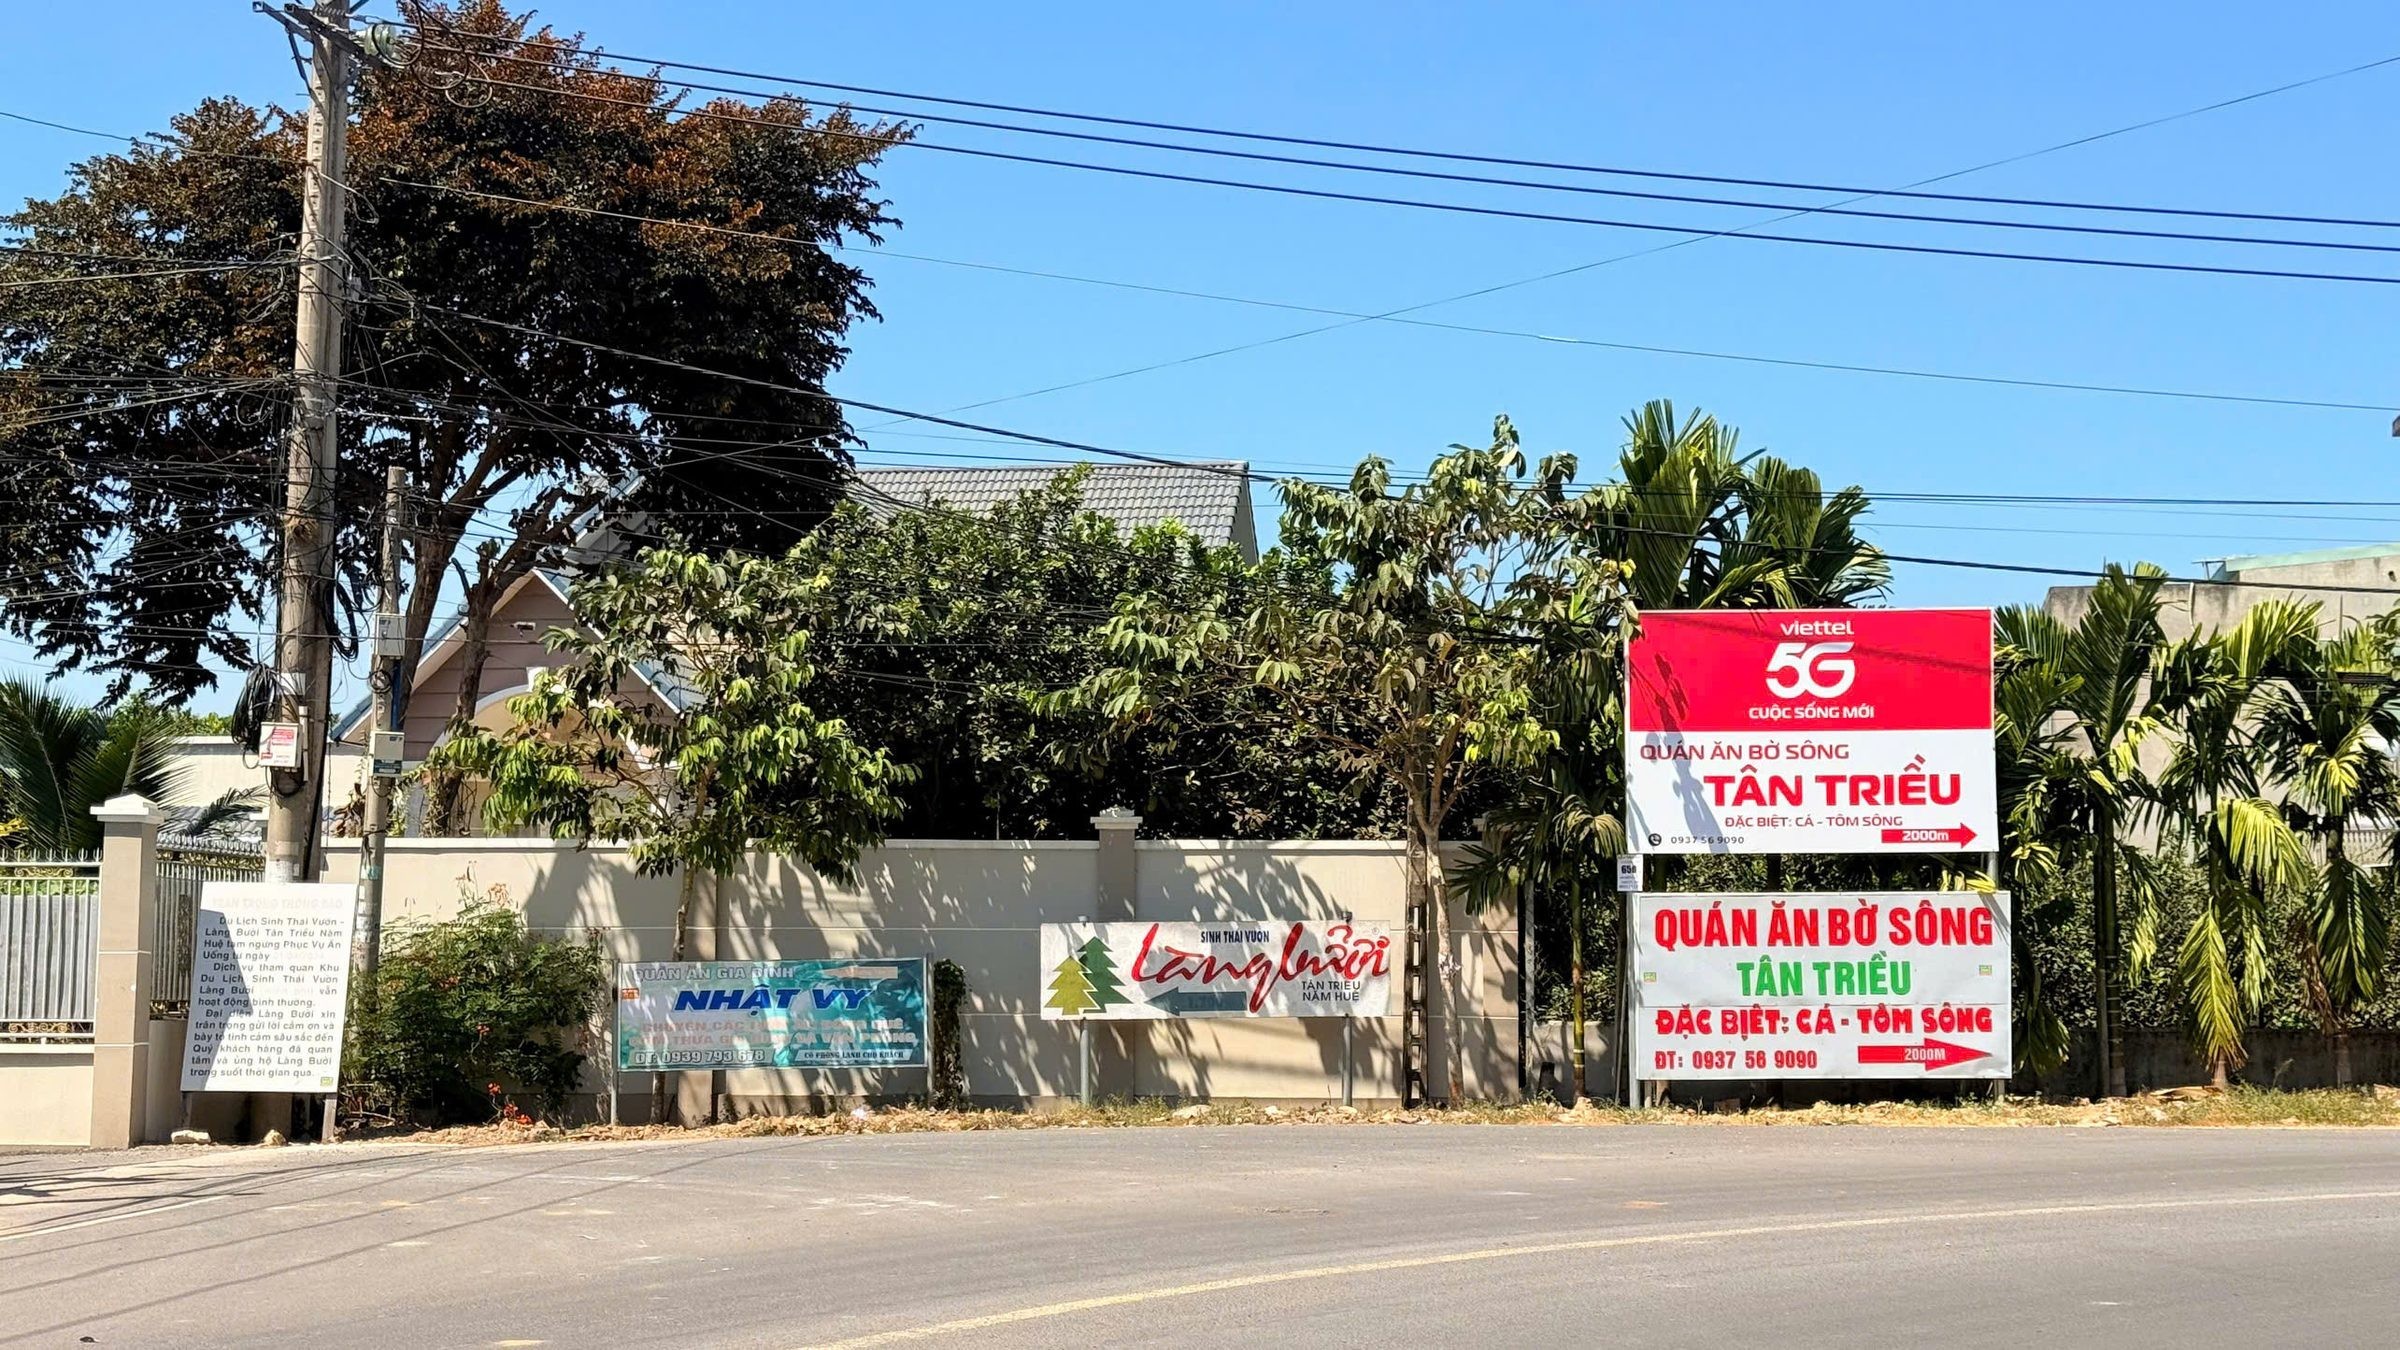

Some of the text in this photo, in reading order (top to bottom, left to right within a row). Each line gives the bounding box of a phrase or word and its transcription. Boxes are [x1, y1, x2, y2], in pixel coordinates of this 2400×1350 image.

[1780, 620, 1854, 636] viettel
[1766, 642, 1855, 698] 5G
[1749, 701, 1874, 721] CUỘC SỐNG MỚI
[1640, 740, 1849, 761] QUÁN ĂN BỜ SÔNG
[1704, 754, 1961, 807] TÂN TRIỀU
[1725, 813, 1753, 829] ĐẶC
[1757, 813, 1792, 829] BIỆT:
[1796, 813, 1814, 827] CÁ
[1827, 814, 1859, 827] TÔM
[1862, 813, 1902, 827] SÔNG
[1671, 836, 1744, 844] 0937 56 9090
[1902, 830, 1949, 842] 2000m
[219, 917, 233, 926] Du
[261, 917, 283, 926] Sinh
[1655, 899, 1993, 952] QUÁN ĂN BỜ SÔNG
[205, 929, 230, 938] Làng
[1201, 931, 1221, 944] SINH
[204, 940, 223, 949] Huệ
[203, 950, 229, 961] Uống
[214, 963, 235, 971] Dịch
[260, 963, 283, 971] tham
[290, 965, 313, 973] quan
[717, 967, 746, 979] GIA
[1737, 951, 1911, 996] TÂN TRIỀU
[201, 974, 214, 982] Du
[199, 986, 224, 995] Làng
[1302, 980, 1325, 990] TÂN
[674, 983, 872, 1016] NHẬT VY
[1303, 990, 1332, 1001] NĂM
[198, 998, 220, 1007] hoạt
[224, 998, 249, 1007] động
[206, 1009, 223, 1018] Đại
[321, 1010, 336, 1018] xin
[196, 1021, 215, 1029] trân
[1656, 1003, 1712, 1039] ĐẶC
[1721, 1004, 1790, 1041] BIỆT:
[1797, 1002, 1836, 1034] CÁ
[1858, 1003, 1912, 1033] TÔM
[1923, 1002, 1992, 1033] SÔNG
[194, 1032, 212, 1042] bày
[193, 1044, 213, 1054] Quý
[308, 1046, 332, 1055] quan
[1904, 1046, 1946, 1062] 2000M
[662, 1051, 702, 1063] 0939
[706, 1051, 732, 1062] 793
[738, 1050, 765, 1062] 678
[1655, 1050, 1684, 1070] ĐT:
[1693, 1050, 1735, 1069] 0937
[1775, 1050, 1817, 1070] 9090
[190, 1069, 217, 1078] trong
[269, 1069, 289, 1078] gian
